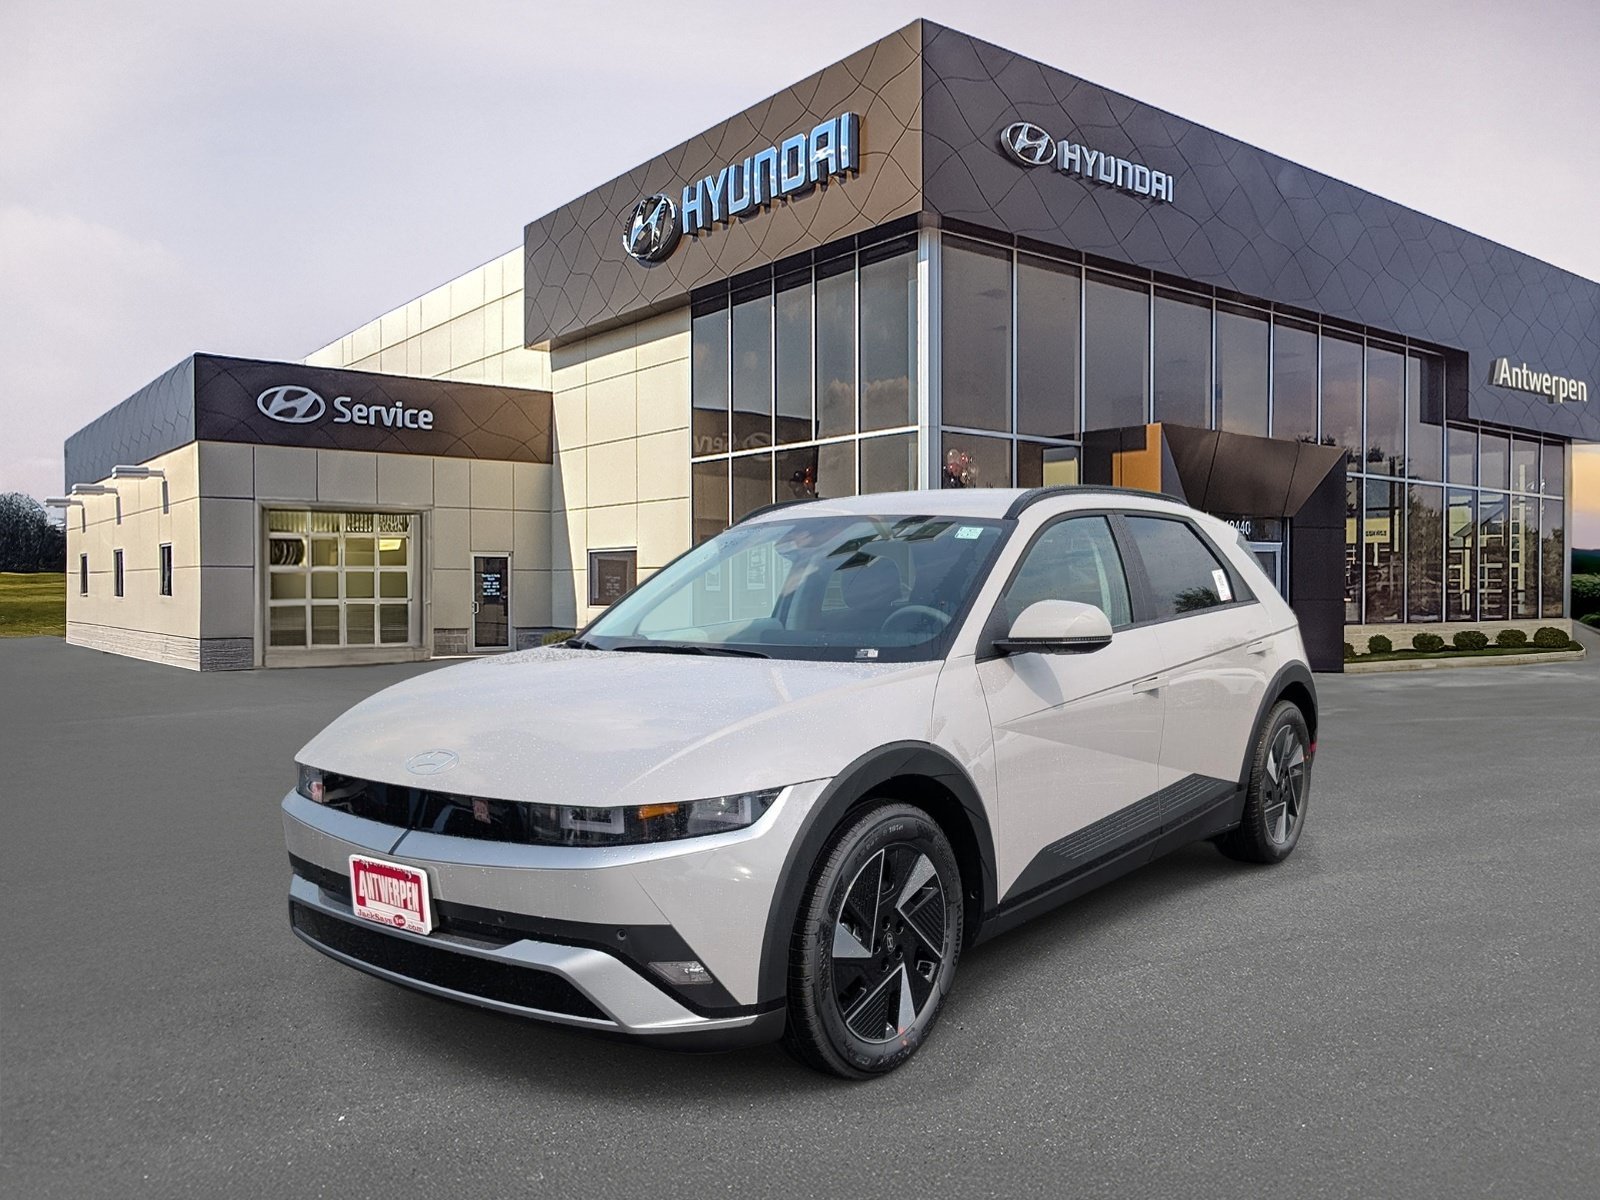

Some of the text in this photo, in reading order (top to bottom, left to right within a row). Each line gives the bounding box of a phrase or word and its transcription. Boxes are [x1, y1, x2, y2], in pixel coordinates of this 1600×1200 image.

[682, 111, 856, 235] HYUNDAI
[1057, 139, 1174, 203] HYUNDAI
[1494, 357, 1588, 404] Antwerpen
[333, 396, 434, 430] Service
[358, 869, 419, 912] ANTWERPEN
[951, 904, 963, 967] KUMHO
